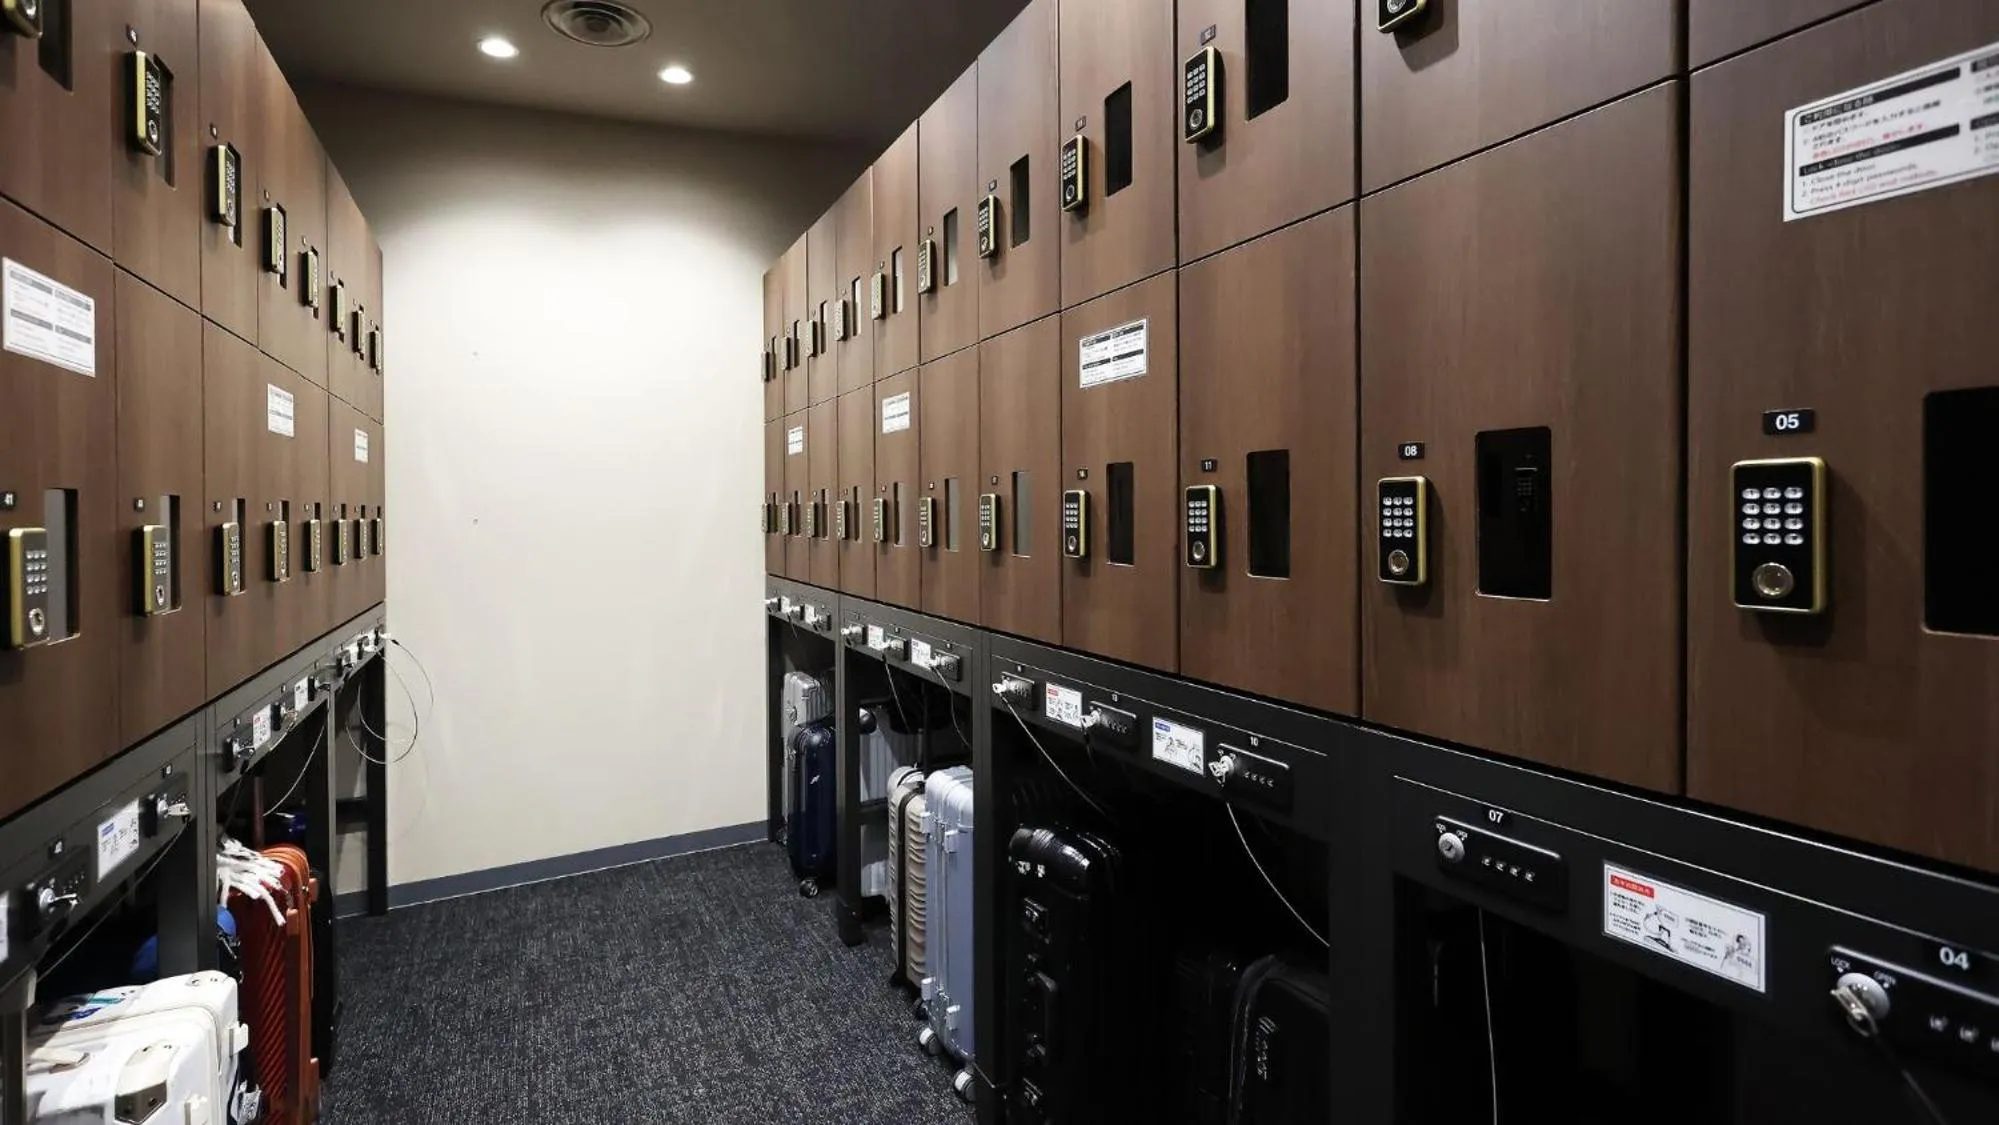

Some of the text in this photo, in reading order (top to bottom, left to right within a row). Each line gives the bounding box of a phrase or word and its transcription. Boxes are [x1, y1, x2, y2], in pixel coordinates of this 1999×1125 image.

[1775, 413, 1800, 430] 05
[1488, 809, 1504, 824] 07
[1939, 946, 1970, 971] 04
